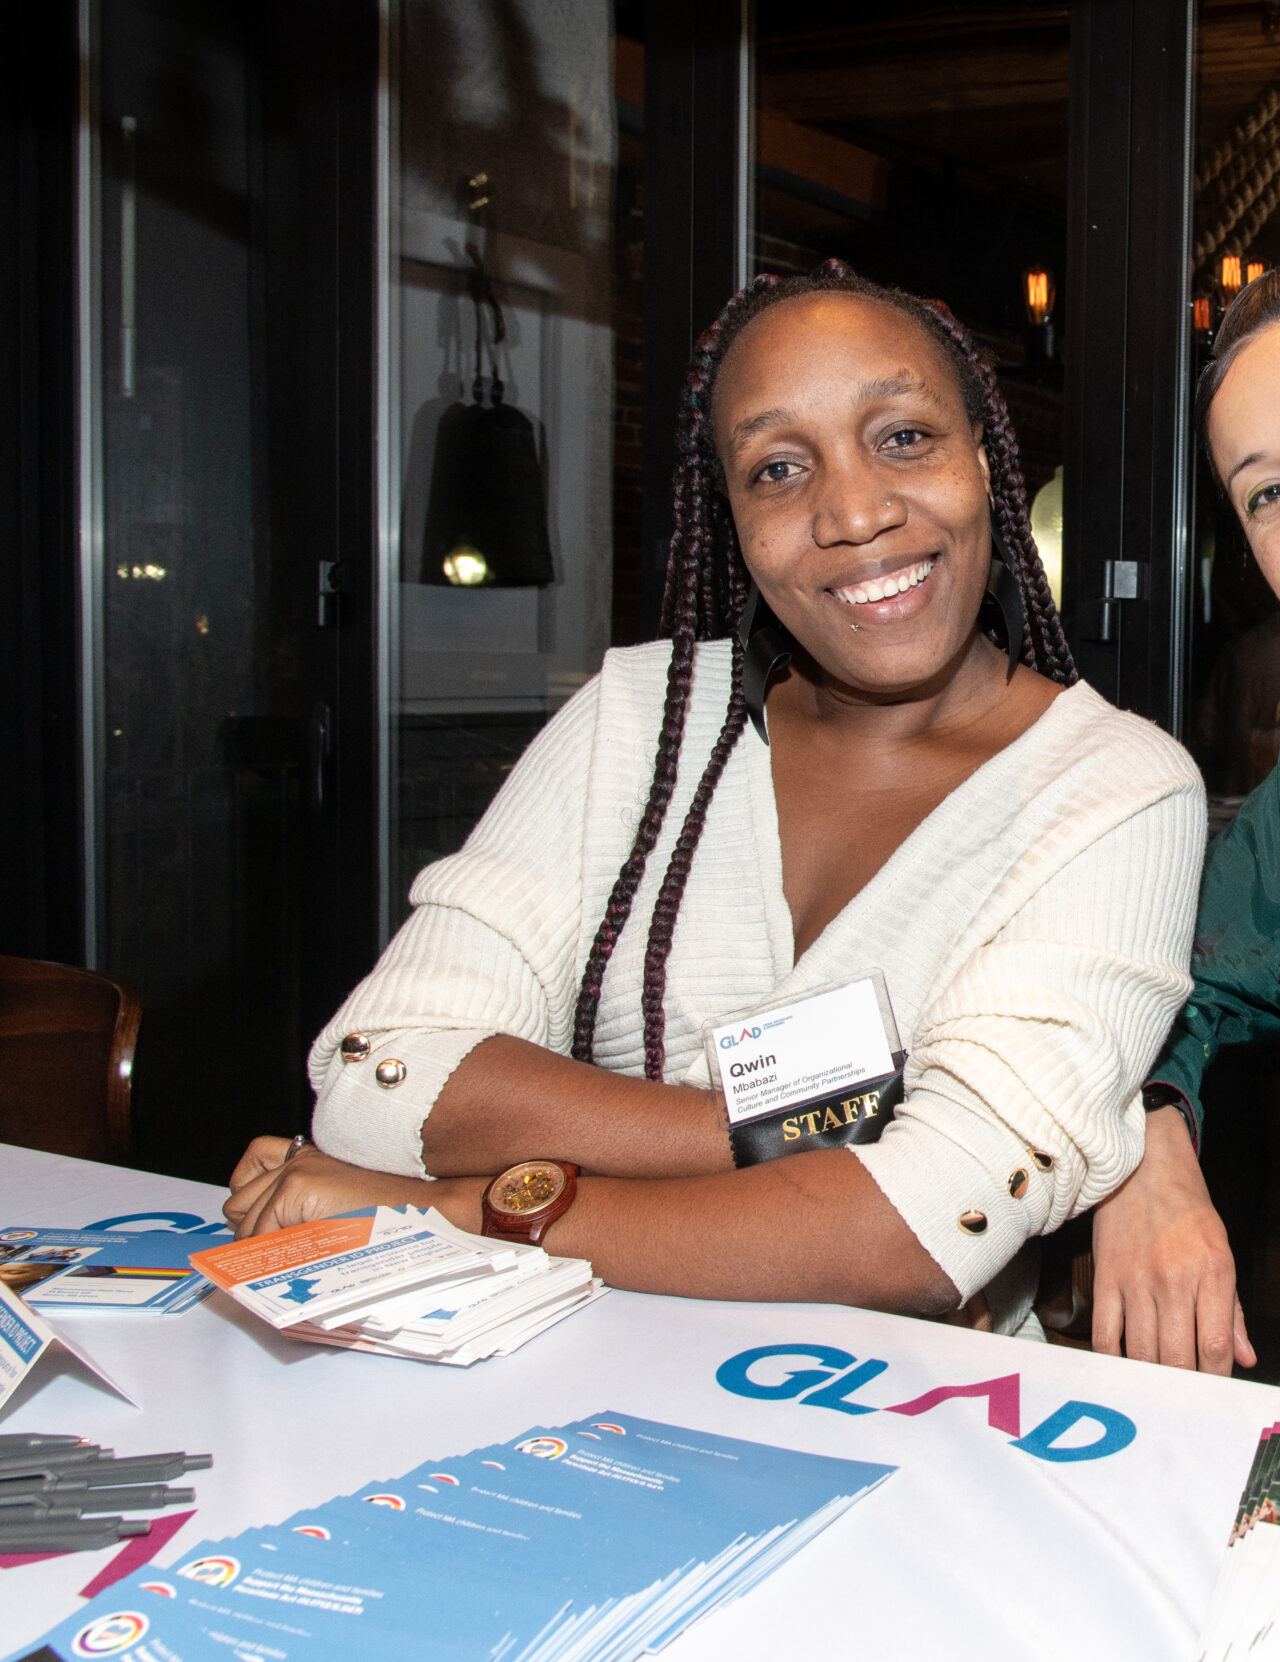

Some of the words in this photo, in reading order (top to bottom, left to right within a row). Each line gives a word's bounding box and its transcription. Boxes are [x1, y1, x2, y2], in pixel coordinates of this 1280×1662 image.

[719, 1025, 763, 1050] GLAD
[729, 1053, 777, 1079] Qwin
[732, 1072, 778, 1095] Mbabazi
[735, 1092, 759, 1106] Senior
[760, 1081, 792, 1099] Manager
[792, 1078, 801, 1087] of
[801, 1061, 853, 1084] Organizational
[737, 1099, 764, 1114] Culture
[764, 1094, 779, 1106] and
[779, 1081, 820, 1101] Community
[821, 1066, 866, 1086] Partnerships
[781, 1090, 881, 1142] STAFF
[255, 1256, 350, 1288] TRANSGENDER
[350, 1250, 363, 1260] ID
[366, 1235, 418, 1254] PROJECT
[340, 1253, 406, 1276] transgender
[407, 1241, 444, 1257] people
[384, 1257, 409, 1269] New
[715, 1343, 1138, 1463] GLAD
[415, 1507, 443, 1520] Protect
[242, 1576, 279, 1590] Support
[252, 1567, 283, 1581] Protect
